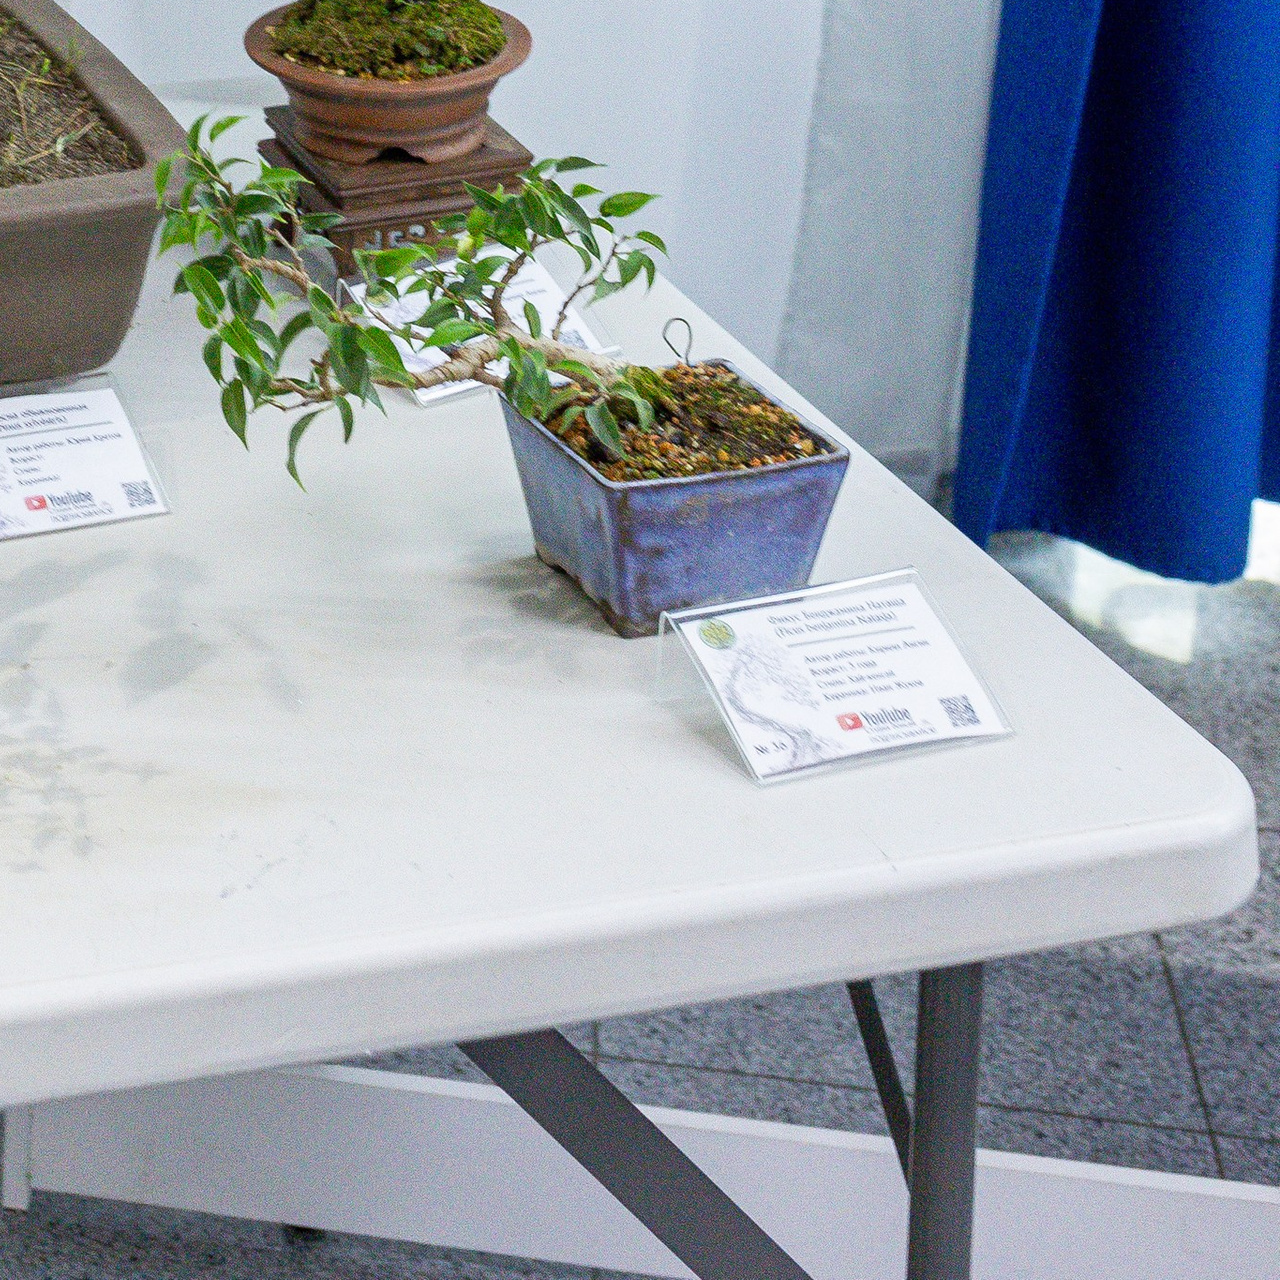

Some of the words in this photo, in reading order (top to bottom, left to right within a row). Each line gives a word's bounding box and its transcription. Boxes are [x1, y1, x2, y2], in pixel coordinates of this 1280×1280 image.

[46, 489, 93, 507] YouTube
[801, 605, 865, 620] Бенджамина
[865, 597, 907, 610] Наташа
[860, 705, 911, 727] YouTube
